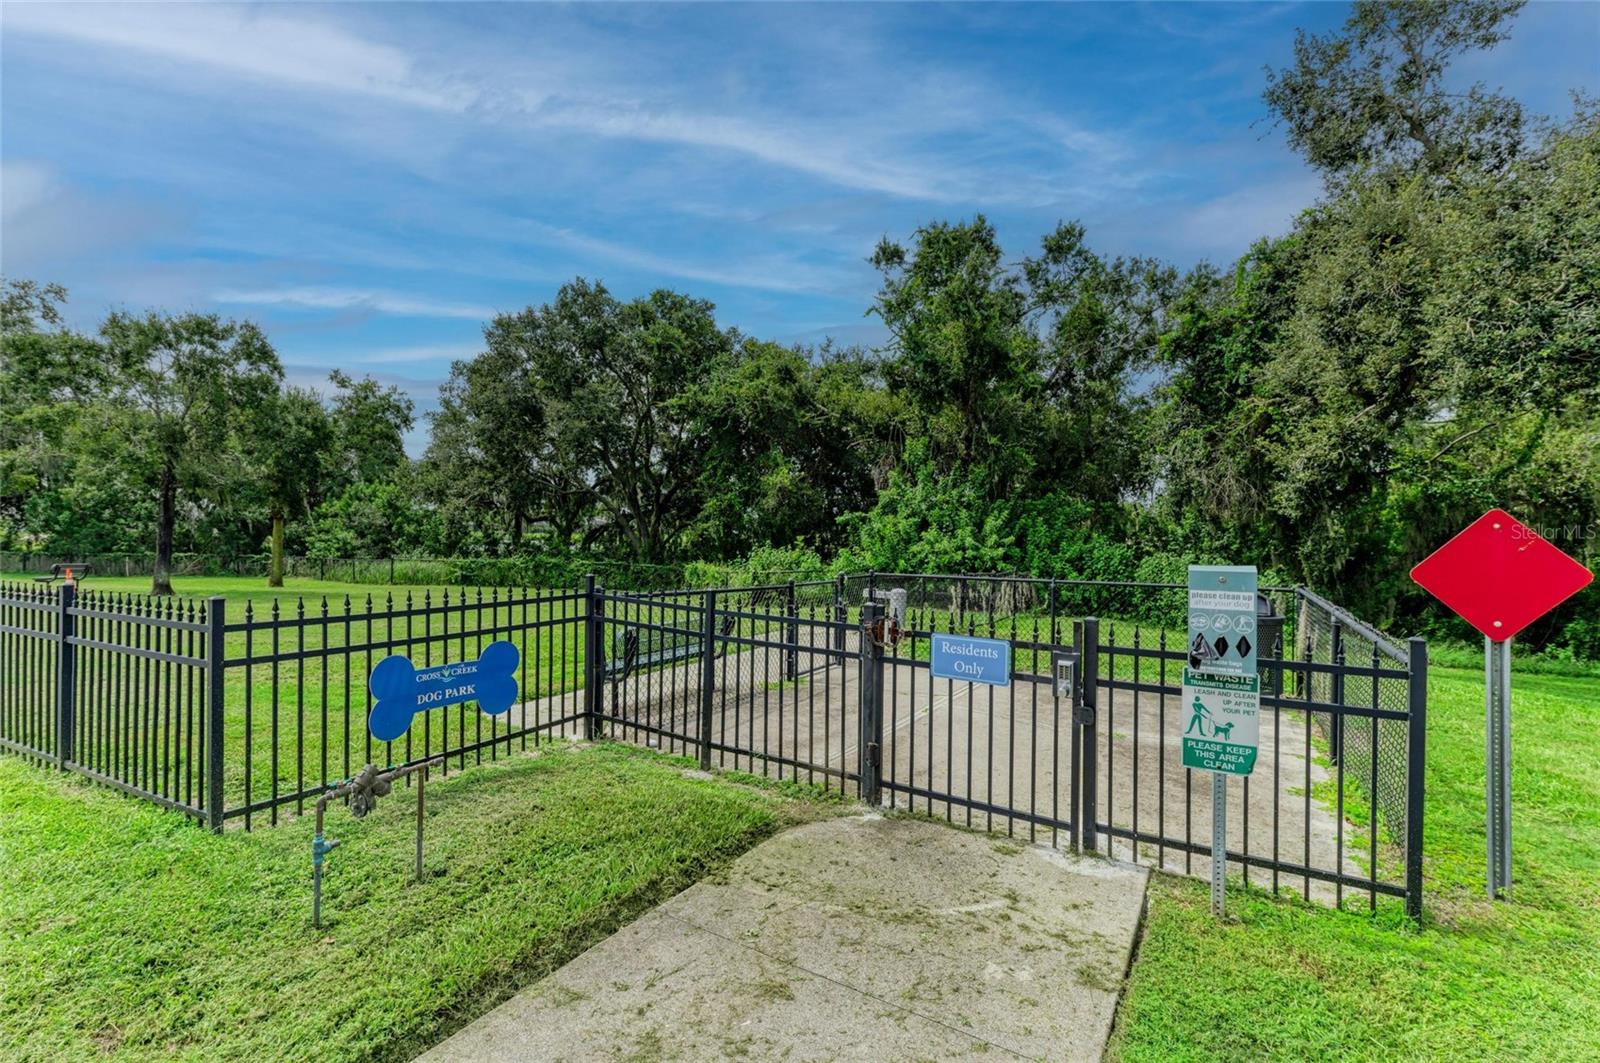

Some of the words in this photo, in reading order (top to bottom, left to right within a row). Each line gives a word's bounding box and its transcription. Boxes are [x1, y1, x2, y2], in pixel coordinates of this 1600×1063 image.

[1192, 591, 1217, 599] please
[1219, 592, 1240, 600] clean
[942, 641, 999, 659] Residents
[416, 672, 440, 682] CROSS
[451, 666, 478, 676] CREEK
[954, 660, 984, 678] Only
[1214, 673, 1254, 684] WASTE
[1190, 680, 1224, 688] TRANSMITS
[1225, 683, 1252, 691] DISEASE
[416, 691, 442, 705] DOG
[445, 684, 475, 698] PARK
[1193, 688, 1216, 696] LEASH
[1233, 693, 1257, 701] CLEAN
[1222, 699, 1233, 707] UP
[1222, 708, 1241, 716] YOUR
[1187, 741, 1223, 753] PLEASE
[1226, 746, 1252, 756] KEEP
[1194, 750, 1216, 760] THIS
[1218, 754, 1245, 764] AREA
[1203, 760, 1236, 771] CLEAN
